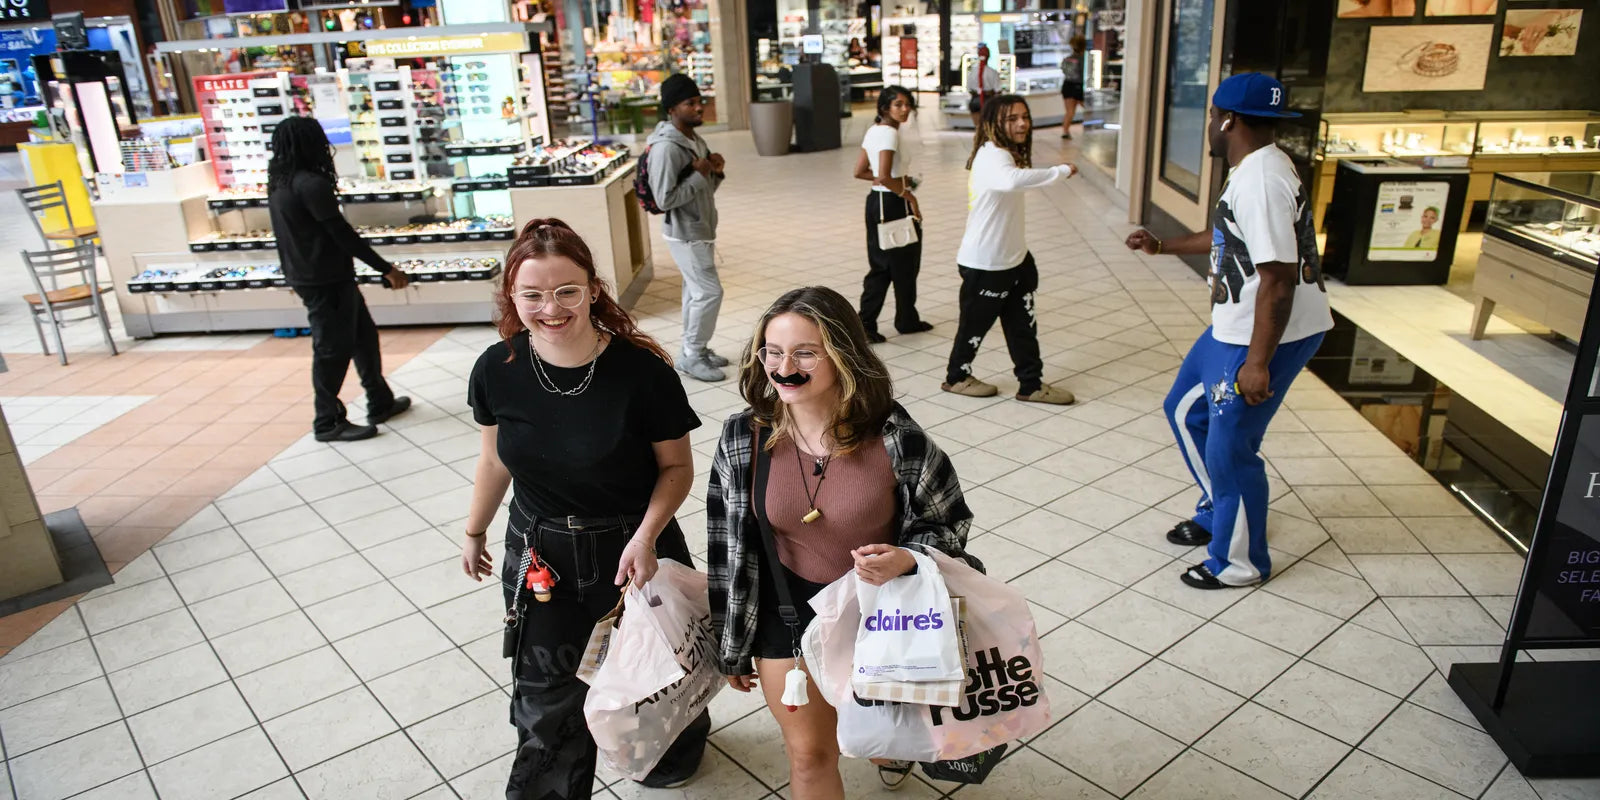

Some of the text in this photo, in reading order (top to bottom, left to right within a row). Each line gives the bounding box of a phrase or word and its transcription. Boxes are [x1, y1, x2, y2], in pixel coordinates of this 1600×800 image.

[386, 40, 440, 53] COLLECTION
[203, 79, 245, 92] ELITE
[1269, 87, 1281, 105] B
[864, 607, 944, 632] claire's
[910, 680, 1040, 726] russe
[946, 761, 978, 774] 100%
